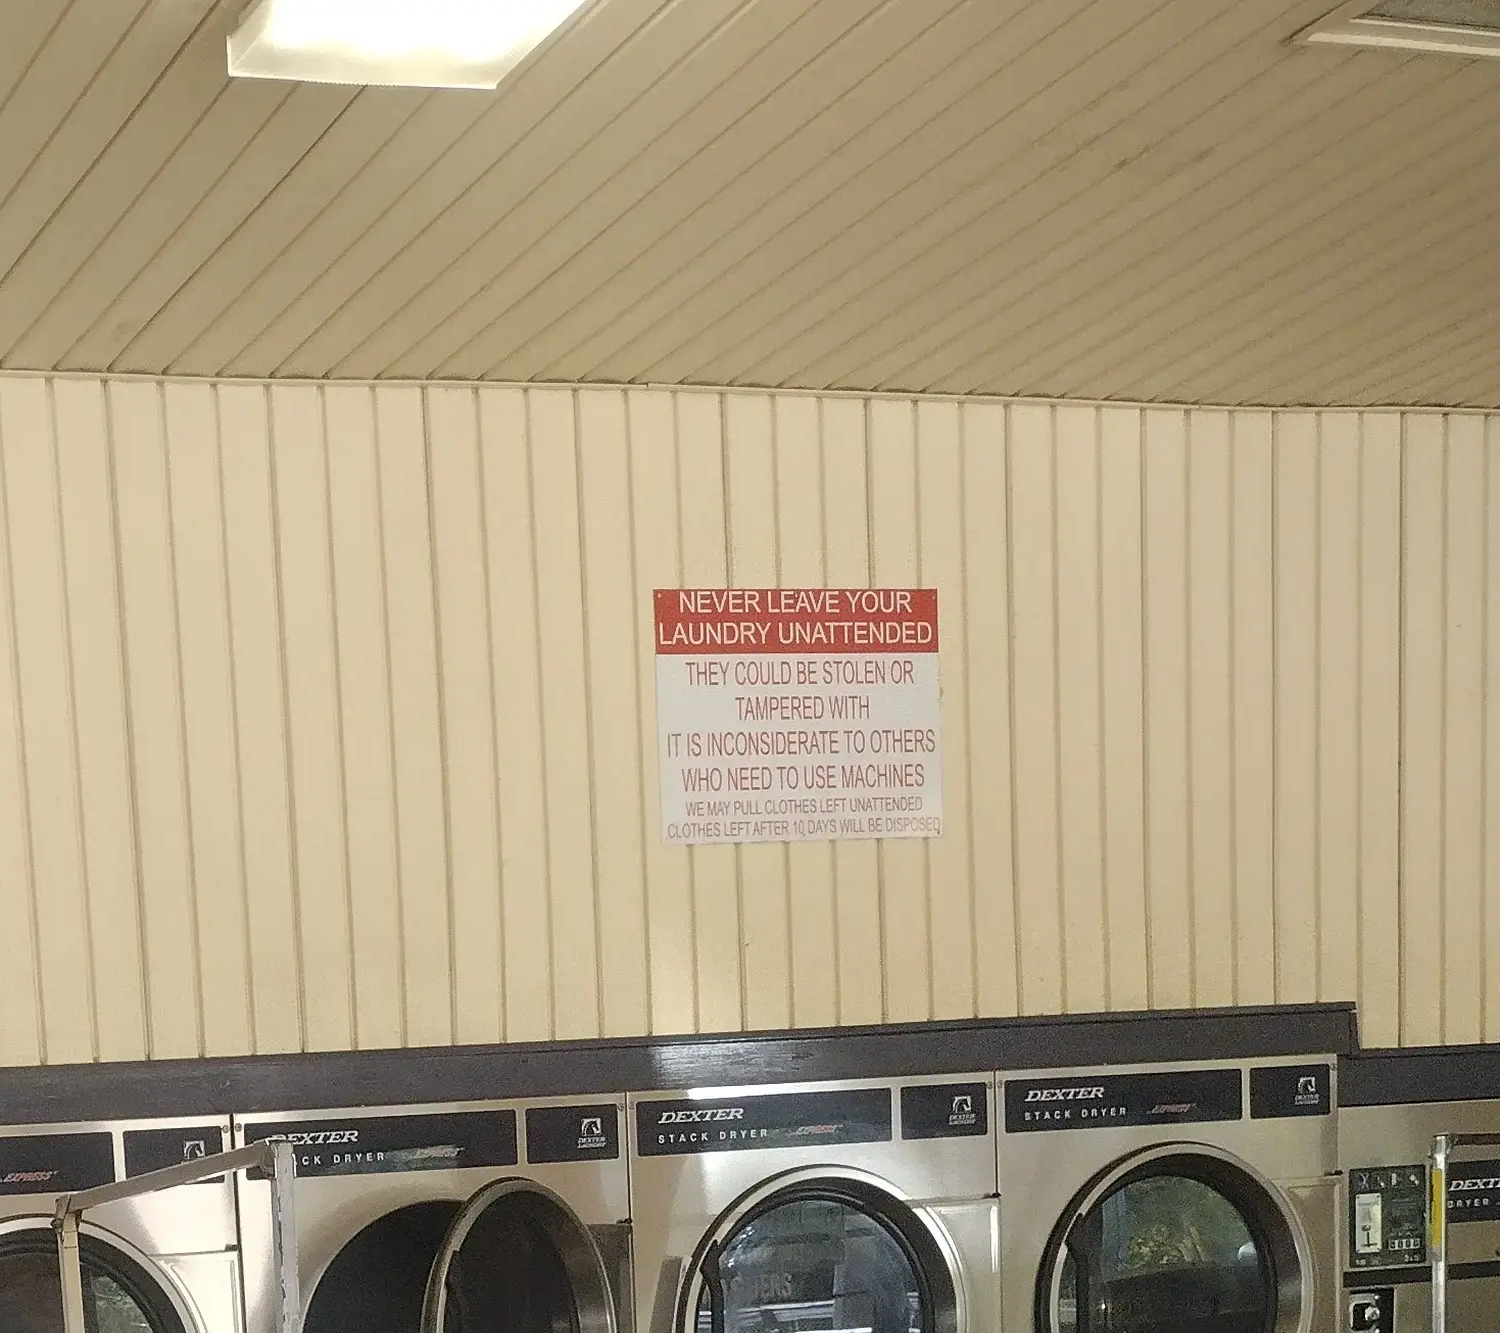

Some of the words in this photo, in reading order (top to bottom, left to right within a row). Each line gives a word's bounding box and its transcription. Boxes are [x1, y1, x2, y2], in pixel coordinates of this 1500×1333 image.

[679, 591, 761, 613] NEVER
[768, 590, 840, 613] LEAVE
[845, 590, 912, 613] YOUR
[659, 622, 771, 645] LAUNDRY
[778, 621, 932, 645] UNATTENDED
[686, 661, 729, 686] THEY
[735, 661, 791, 686] COULD
[797, 661, 818, 685] BE
[822, 660, 886, 685] STOLEN
[890, 660, 914, 685] OR
[735, 696, 824, 721] TAMPERED
[829, 695, 870, 720] WITH
[668, 734, 681, 757] IT
[687, 733, 702, 756] IS
[708, 731, 839, 756] INCONSIDERATE
[844, 731, 865, 754] TO
[870, 729, 936, 754] OTHERS
[682, 767, 722, 792] WHO
[727, 767, 772, 791] NEED
[777, 766, 799, 790] TO
[804, 765, 836, 789] USE
[841, 764, 924, 789] MACHINES
[685, 802, 705, 817] WE
[707, 801, 730, 816] MAY
[734, 800, 763, 815] PULL
[765, 799, 817, 814] CLOTHES
[820, 798, 847, 813] LEFT
[850, 797, 923, 812] UNATTENDED
[668, 823, 721, 838] CLOTHES
[724, 822, 751, 837] LEFT
[752, 820, 790, 836] AFTER
[793, 820, 805, 835] 10
[808, 819, 837, 835] DAYS
[839, 818, 866, 833] WILL
[868, 818, 883, 832] BE
[886, 816, 940, 832] DISPOSED
[1024, 1087, 1104, 1102] DEXTER
[657, 1108, 744, 1124] DEXTER
[1024, 1109, 1072, 1121] STACK
[1080, 1106, 1127, 1117] DRYER
[658, 1133, 708, 1144] STACK
[719, 1129, 768, 1141] DRYER
[333, 1152, 384, 1164] DRYER
[1449, 1178, 1500, 1191] DEXT
